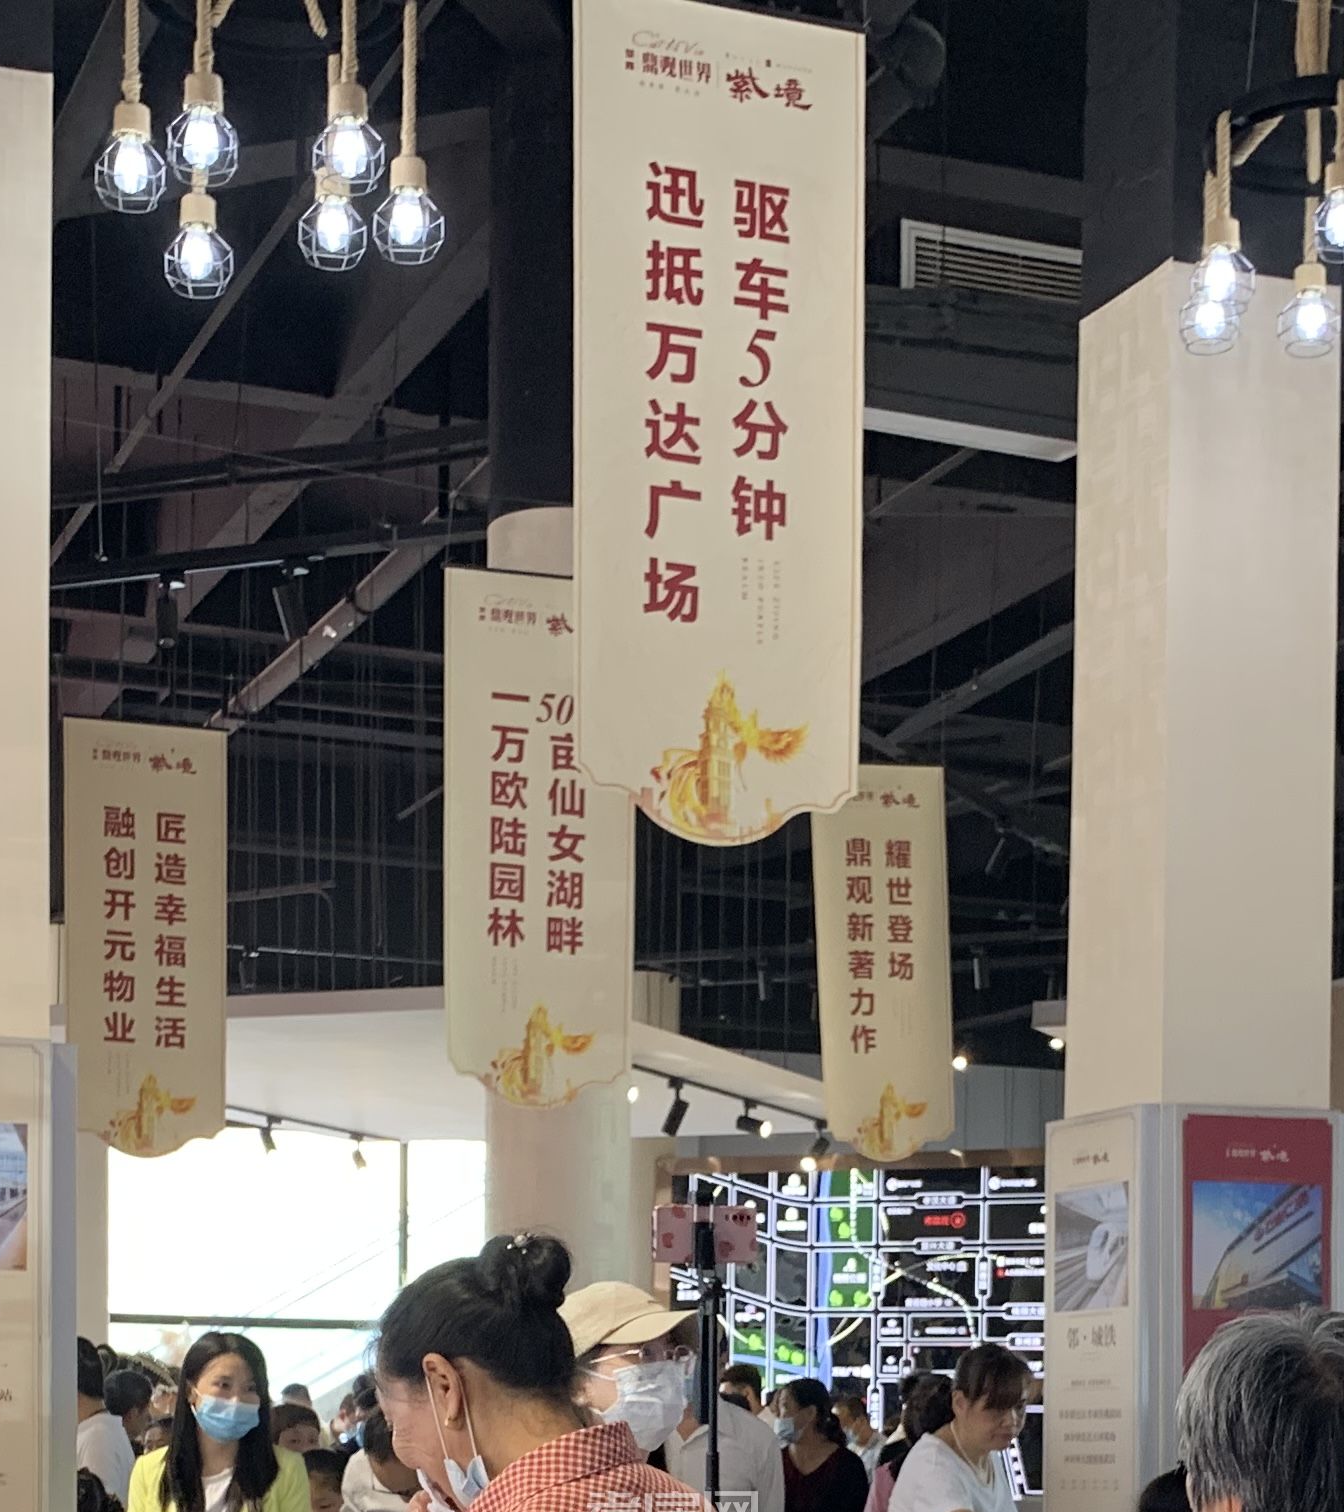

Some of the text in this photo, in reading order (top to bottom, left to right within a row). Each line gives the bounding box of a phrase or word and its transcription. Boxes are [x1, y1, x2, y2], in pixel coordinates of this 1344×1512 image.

[644, 161, 705, 626] 迅抵万达广场
[730, 179, 792, 542] 驱车5分钟
[104, 806, 136, 1045] 融创开元物业
[155, 811, 187, 1050] 匠造幸福生活
[487, 690, 531, 949] 一万欧陆园林
[536, 692, 587, 956] 50亩仙女湖畔
[885, 838, 915, 982] 耀世登场
[845, 838, 878, 1056] 鼎观新著力作
